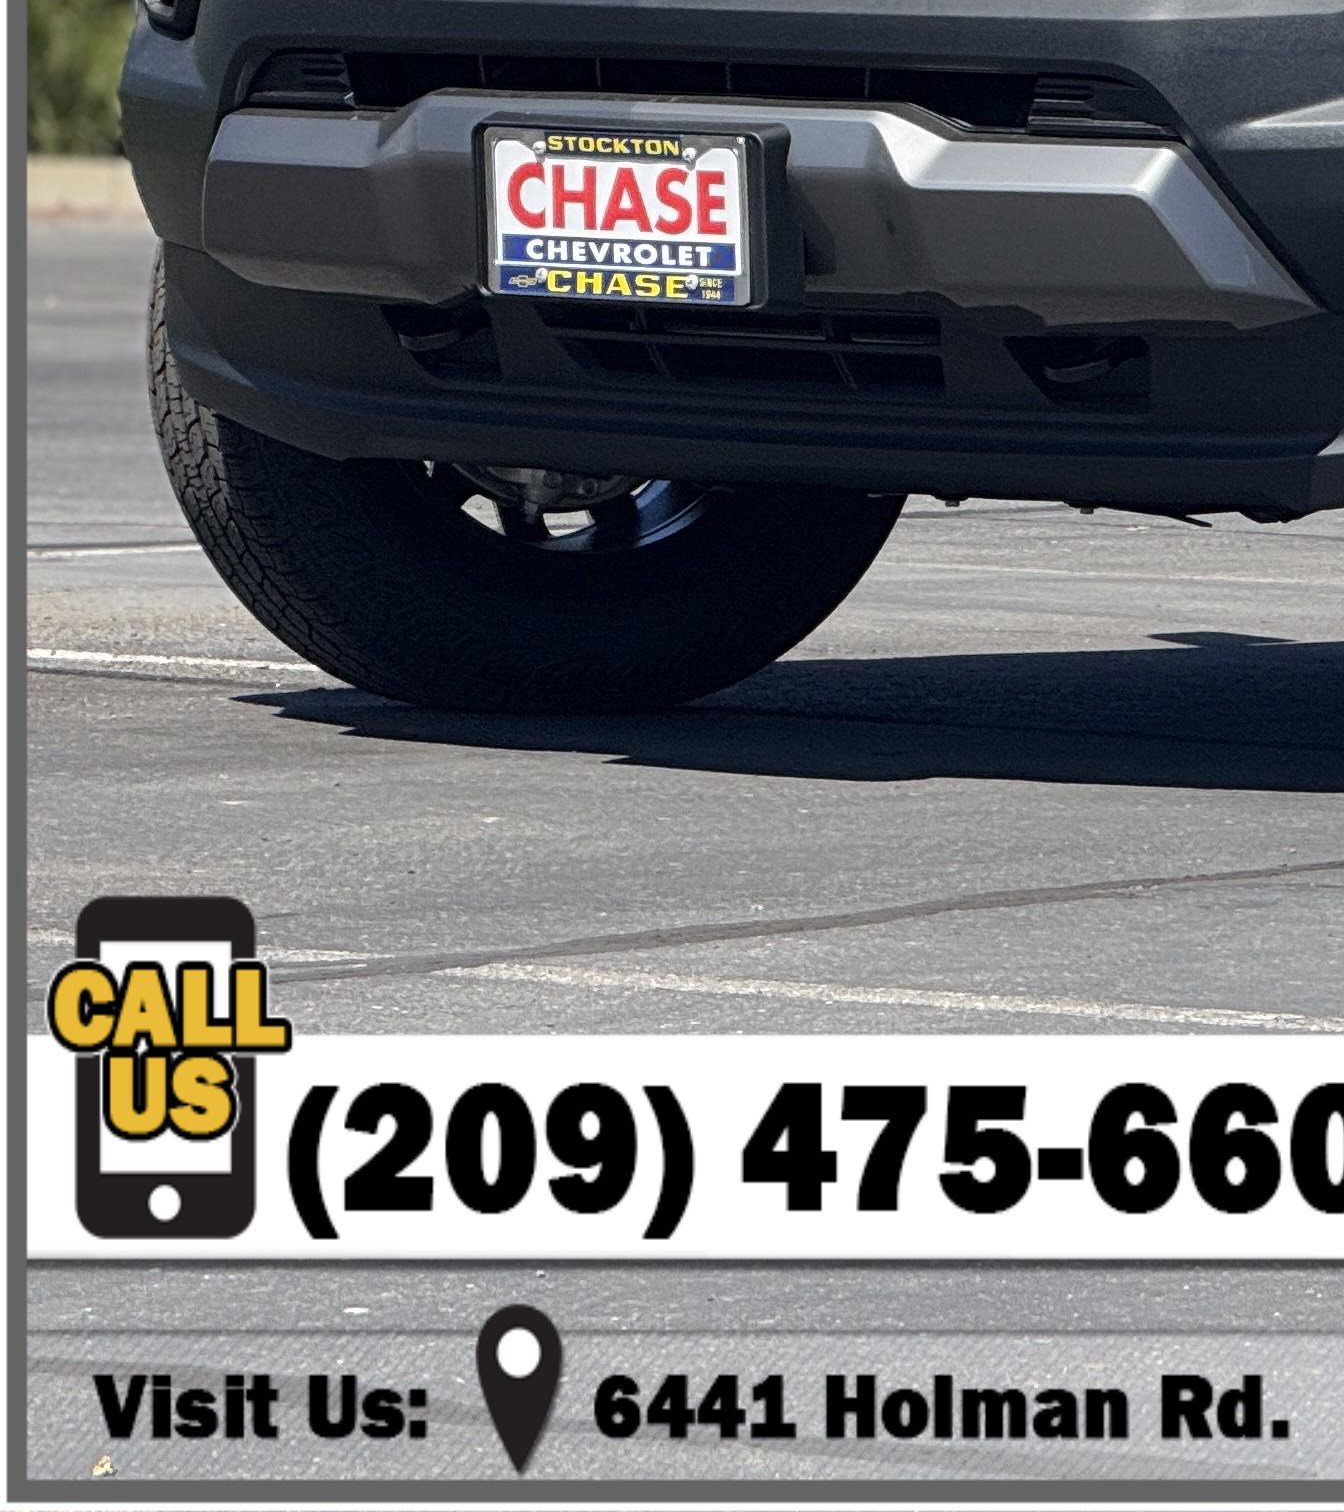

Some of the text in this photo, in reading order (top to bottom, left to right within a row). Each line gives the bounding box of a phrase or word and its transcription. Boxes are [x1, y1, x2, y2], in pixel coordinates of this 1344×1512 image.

[546, 134, 680, 156] STOCKTON
[507, 161, 727, 236] CHASE
[525, 238, 712, 267] CHEVROLET
[546, 269, 689, 299] CHASE
